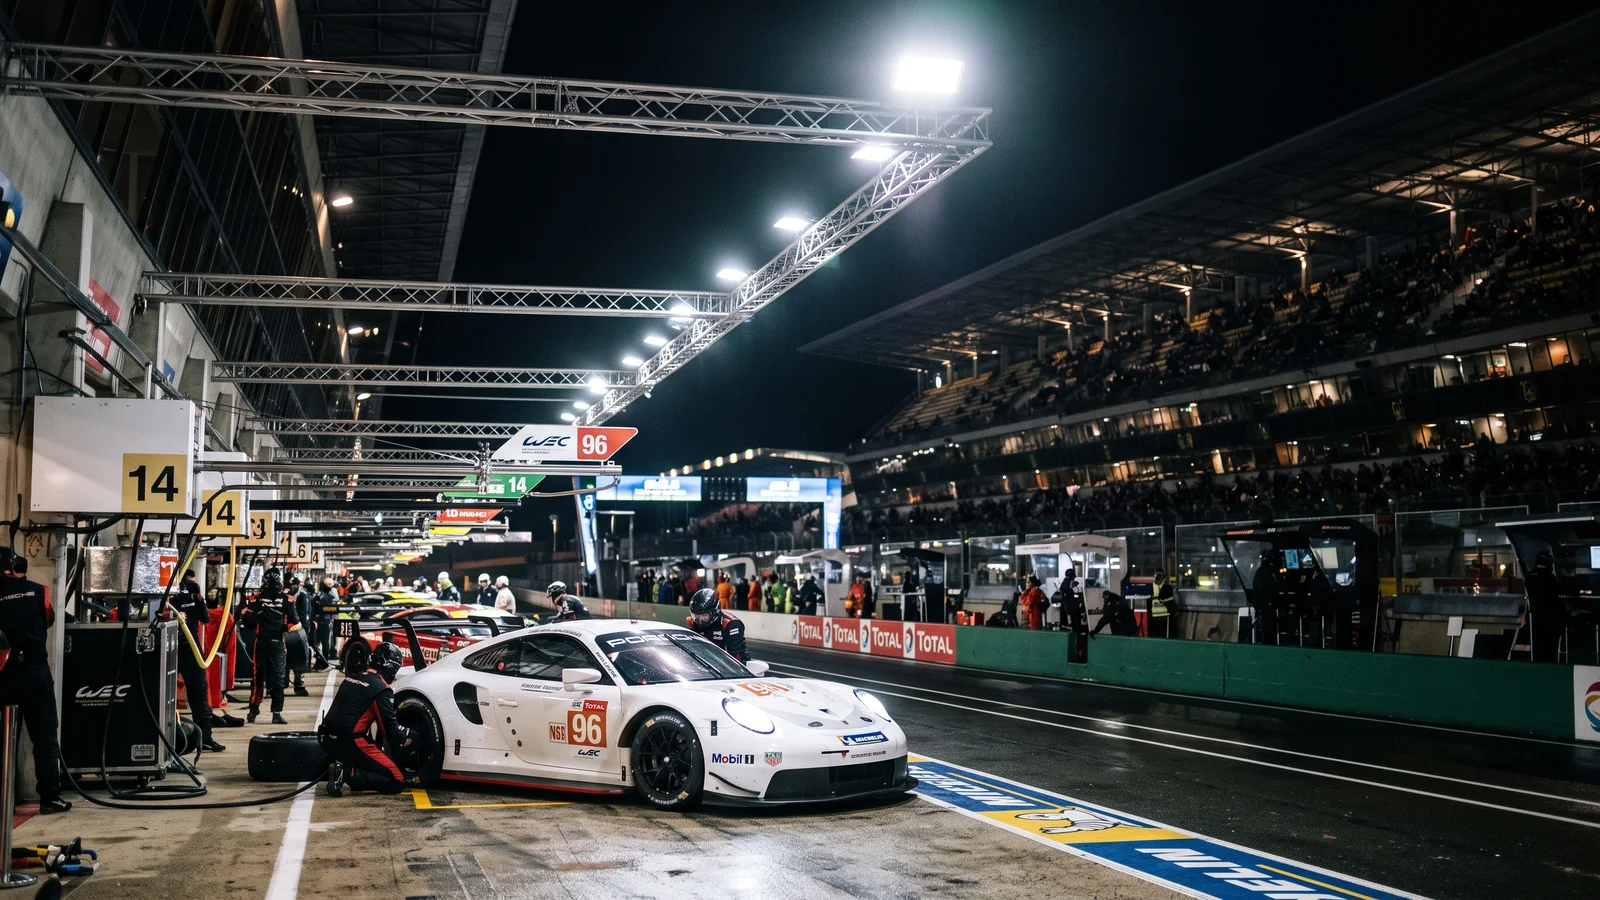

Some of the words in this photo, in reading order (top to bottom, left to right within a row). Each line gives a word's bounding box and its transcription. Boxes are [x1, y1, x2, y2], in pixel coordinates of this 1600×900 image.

[522, 435, 571, 447] WEC
[582, 434, 608, 455] 96
[129, 465, 178, 501] 14
[508, 476, 527, 493] 14
[202, 500, 235, 526] 14
[800, 622, 822, 640] TOTAL
[833, 624, 859, 644] TOTAL
[872, 627, 902, 649] TOTAL
[916, 630, 953, 654] TOTAL
[75, 684, 132, 698] WEC
[585, 702, 605, 710] TOTAL
[572, 713, 602, 745] 96
[577, 749, 601, 757] WEC
[712, 753, 742, 764] Mobil
